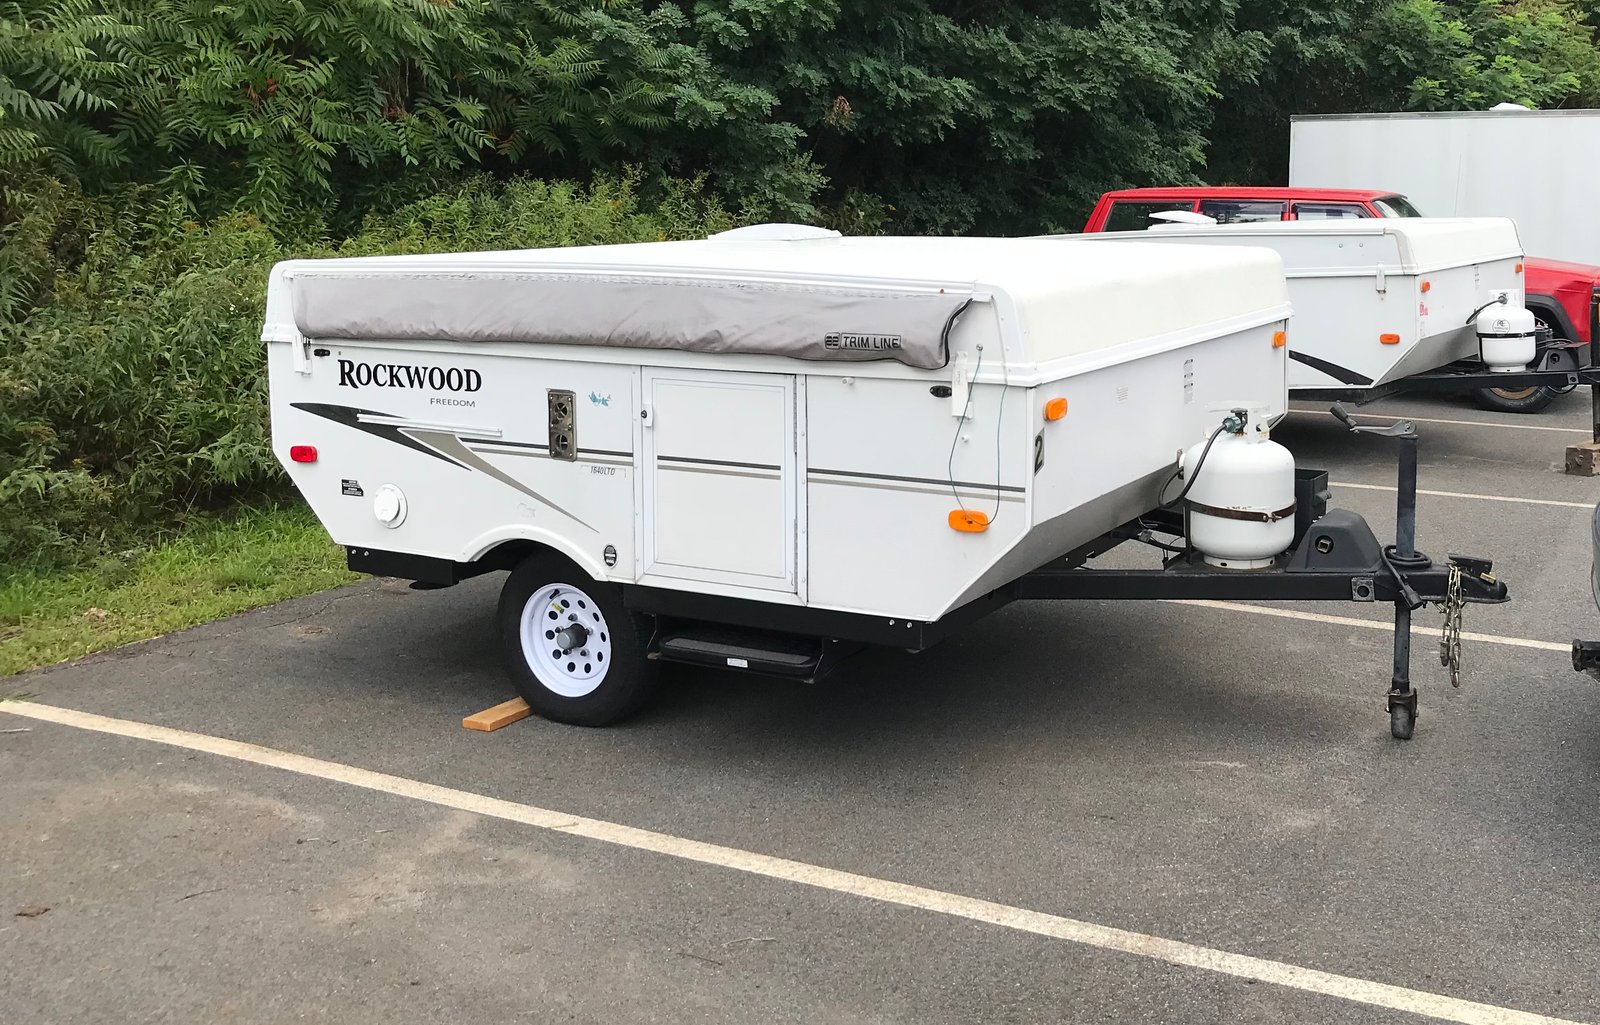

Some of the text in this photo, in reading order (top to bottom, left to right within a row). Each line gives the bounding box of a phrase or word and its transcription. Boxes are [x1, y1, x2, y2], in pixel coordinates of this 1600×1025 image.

[843, 336, 900, 350] TRIM LINE
[337, 359, 482, 392] ROCKWOOD
[430, 397, 476, 408] FREEDOM
[1035, 434, 1043, 474] 2
